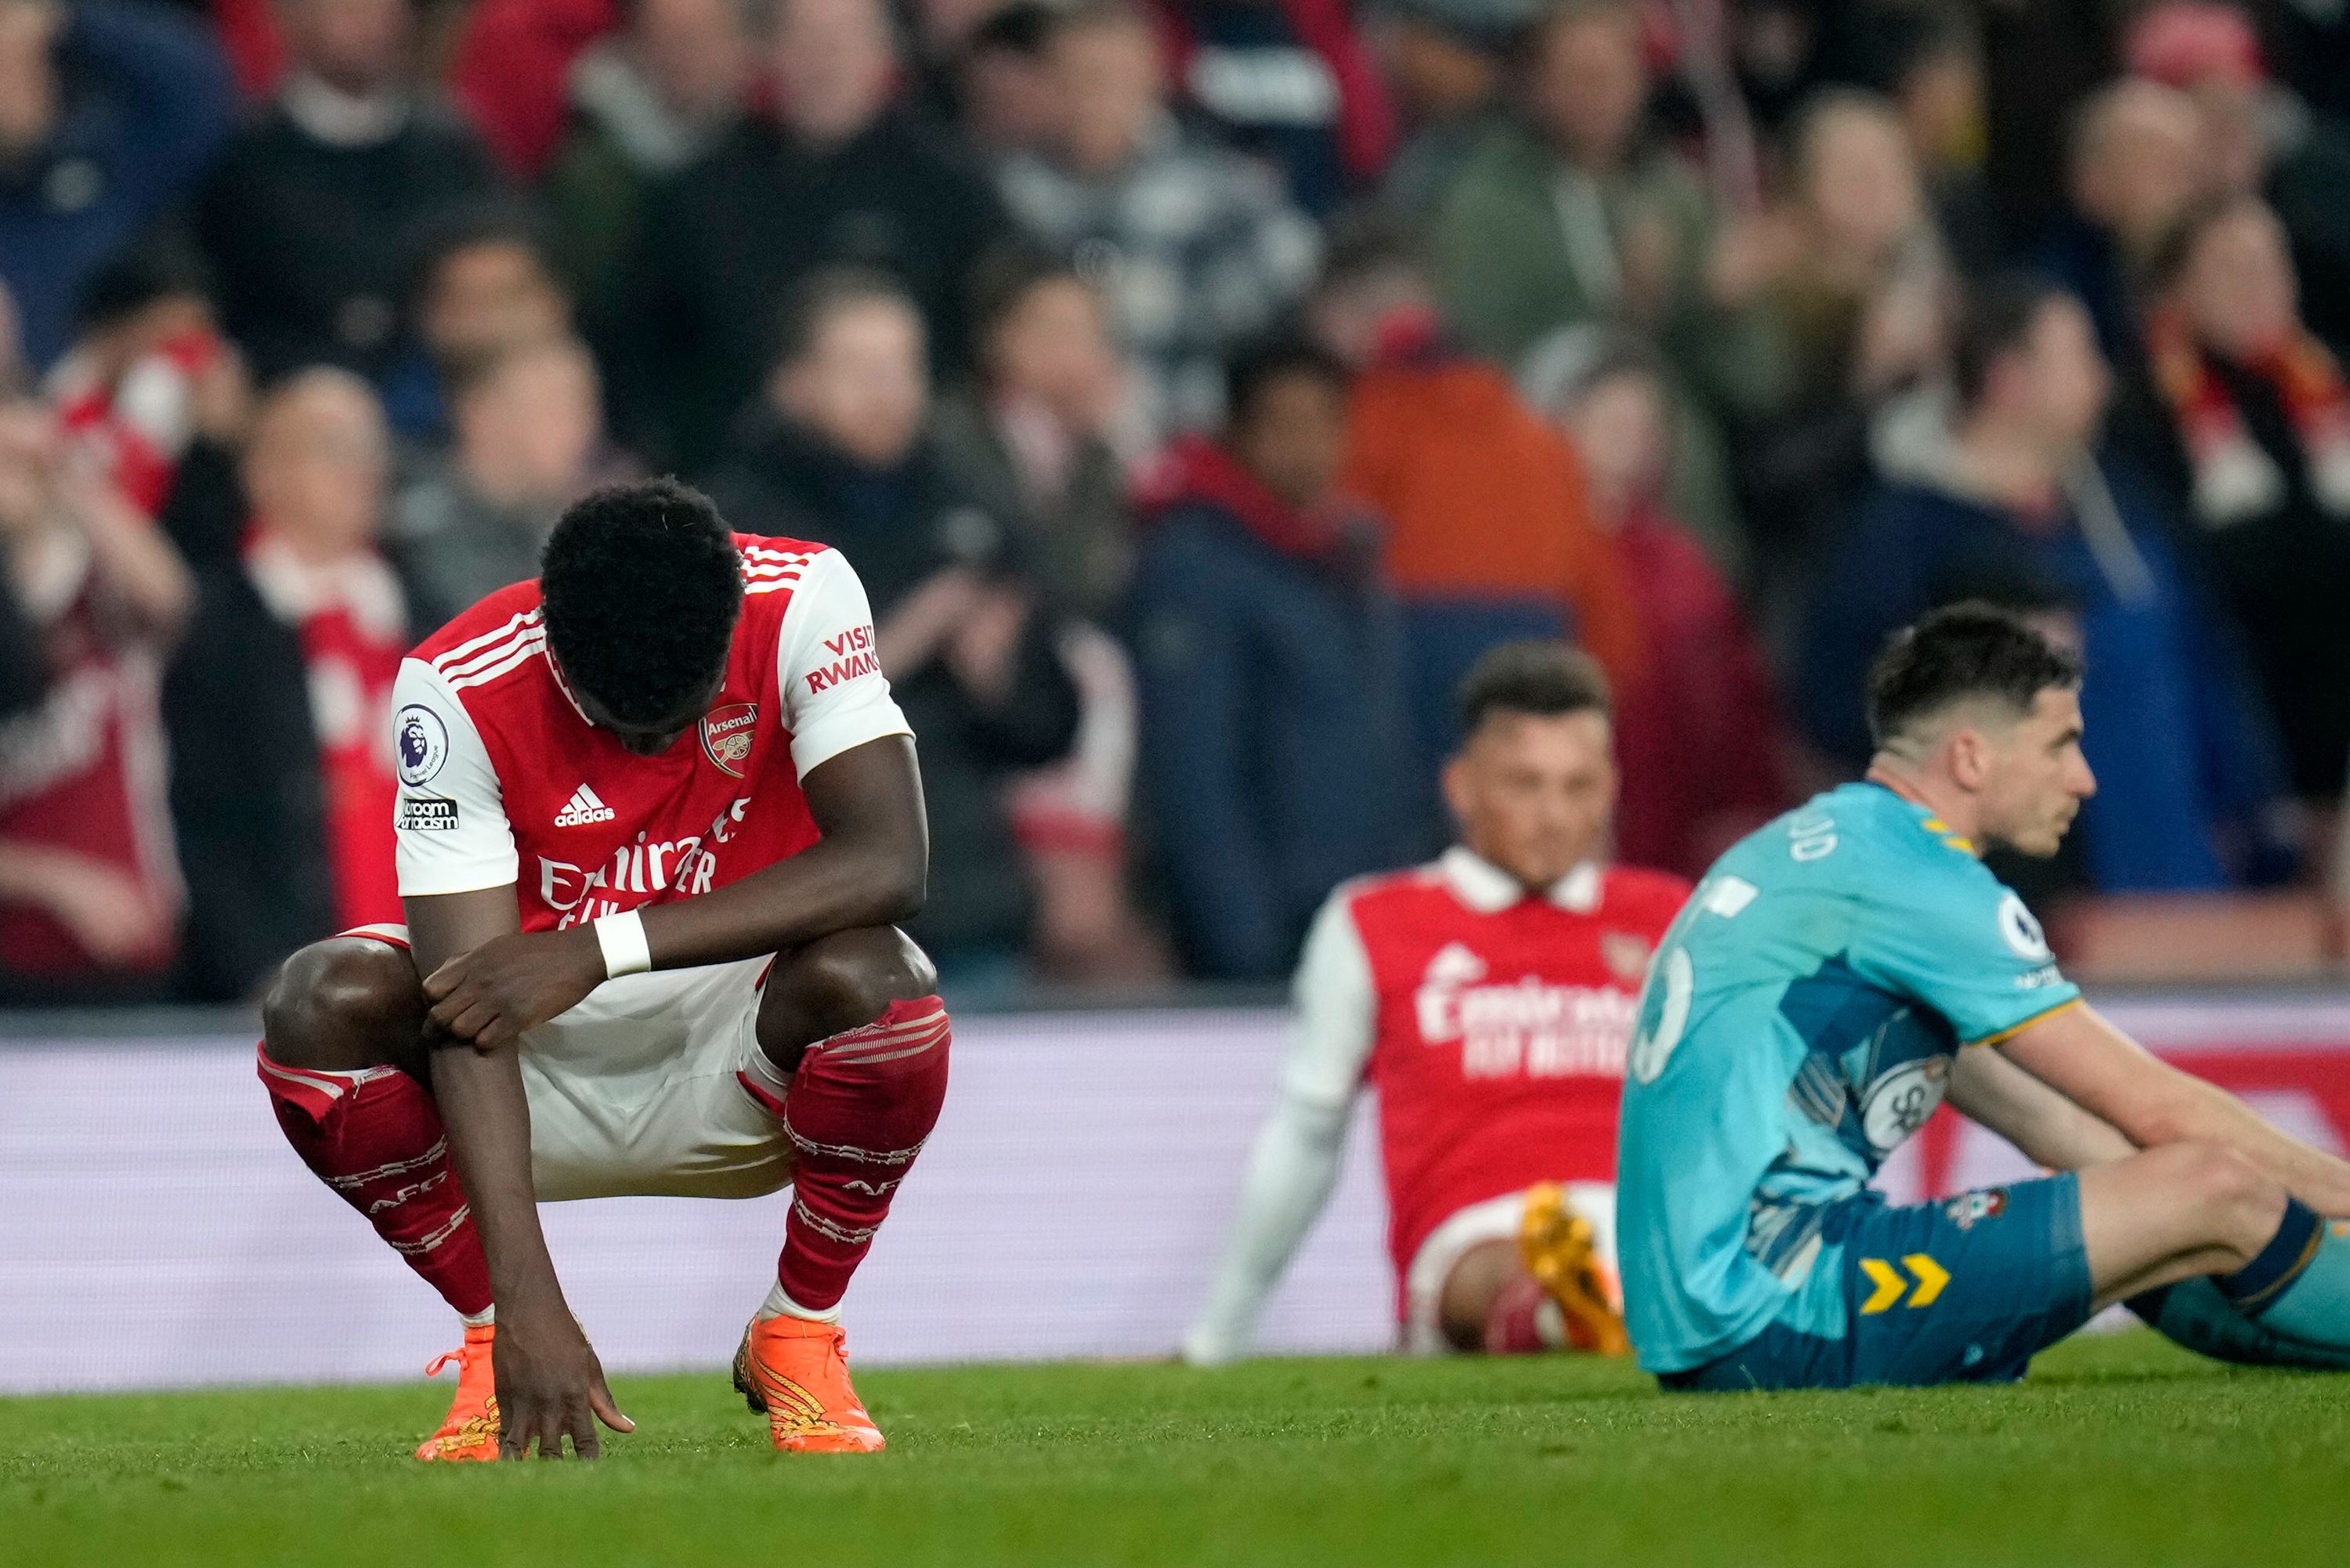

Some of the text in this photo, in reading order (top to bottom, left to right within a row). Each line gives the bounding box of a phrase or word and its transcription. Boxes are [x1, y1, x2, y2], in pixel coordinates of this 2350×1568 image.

[823, 625, 875, 656] VISIT
[805, 651, 878, 695] RWAN
[708, 712, 755, 736] Arsenal
[426, 745, 439, 770] League
[554, 807, 615, 828] adidas
